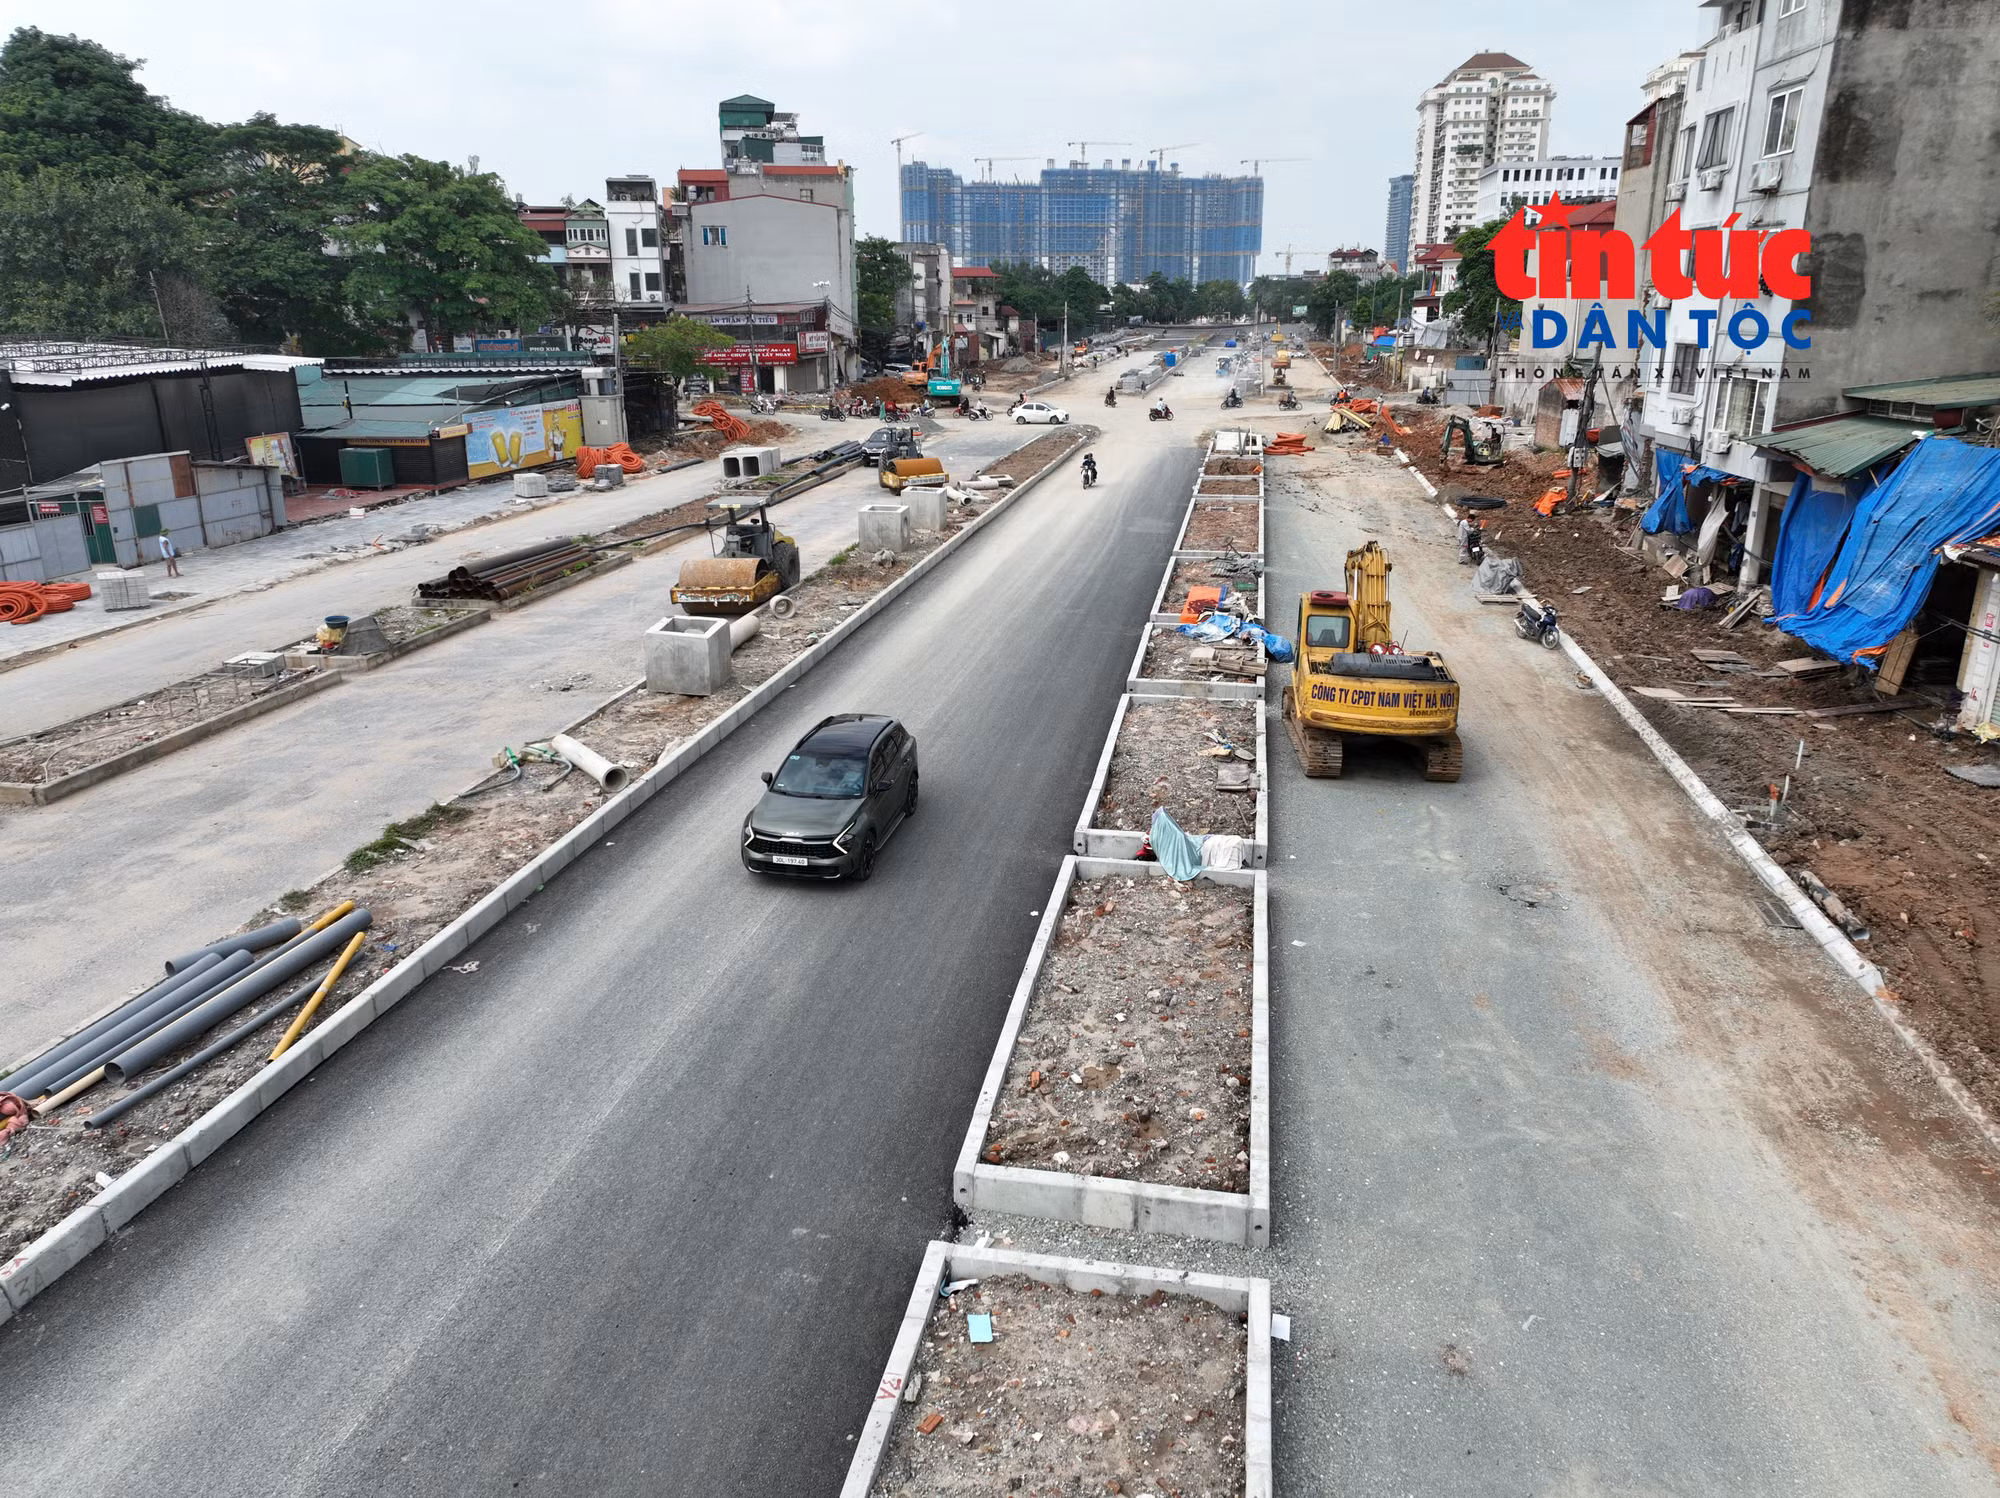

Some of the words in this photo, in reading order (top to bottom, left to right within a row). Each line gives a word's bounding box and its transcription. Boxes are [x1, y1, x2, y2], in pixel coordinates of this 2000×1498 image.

[1311, 681, 1336, 702] CÔNG
[1338, 687, 1350, 704] TY
[1351, 689, 1377, 707] CPĐT
[1378, 691, 1401, 708] NAM
